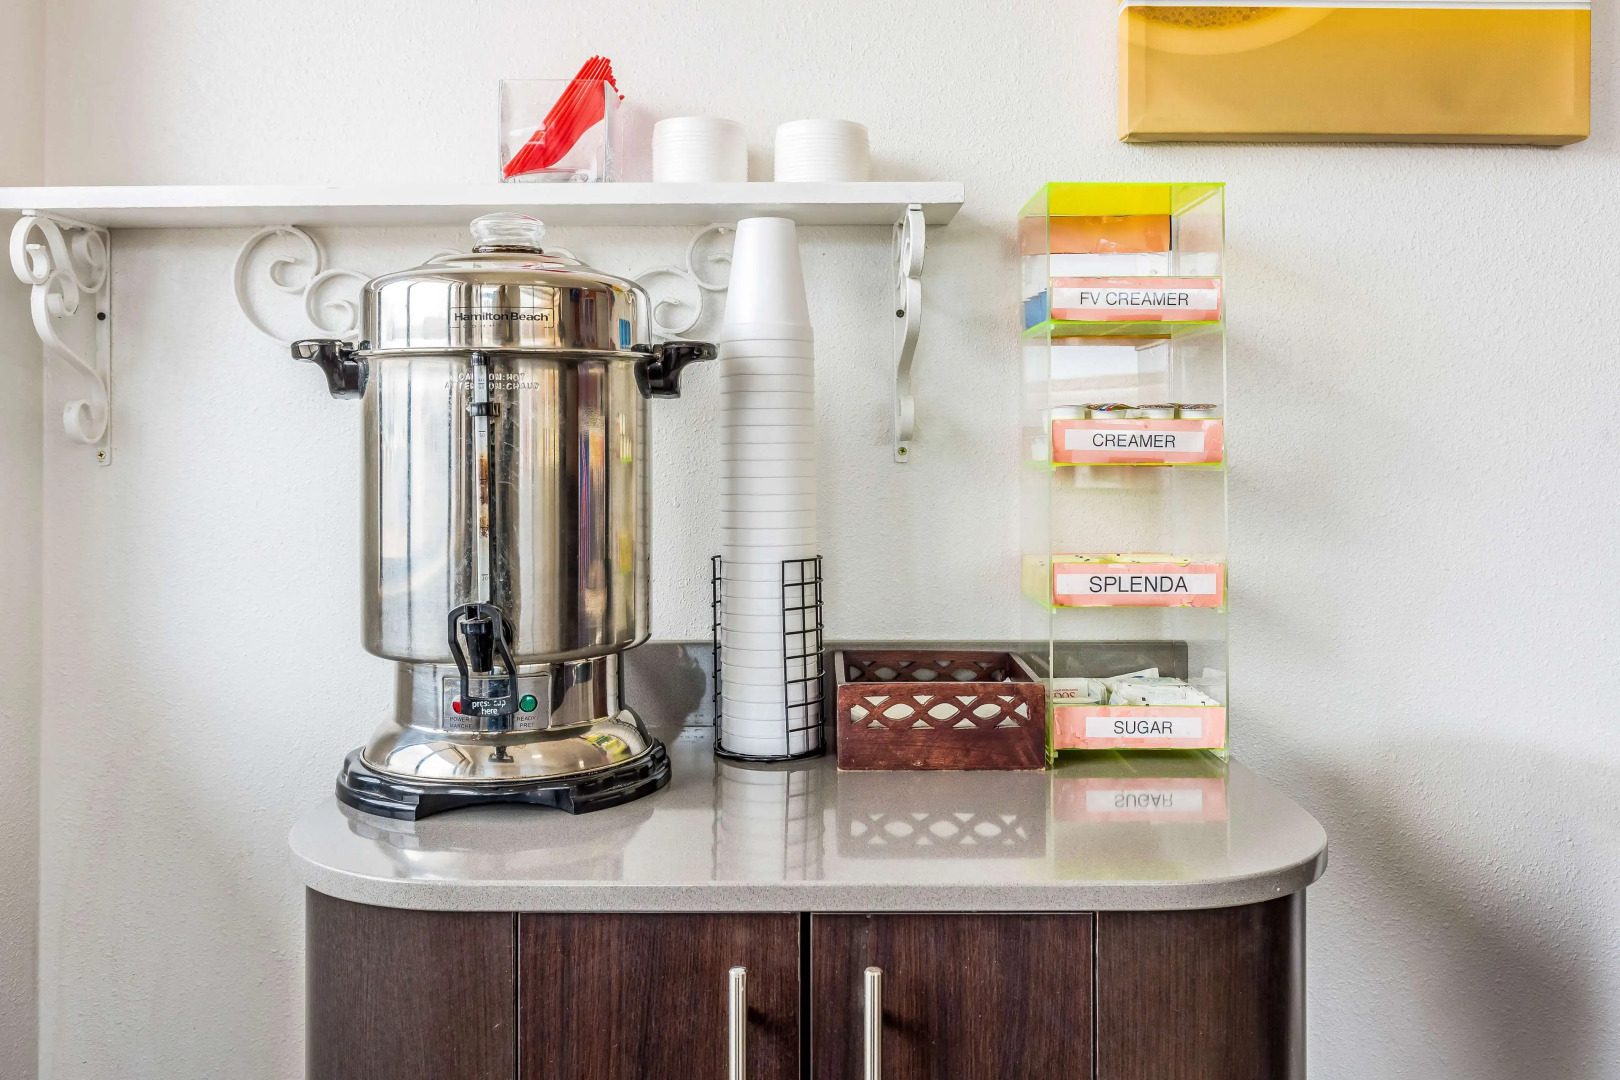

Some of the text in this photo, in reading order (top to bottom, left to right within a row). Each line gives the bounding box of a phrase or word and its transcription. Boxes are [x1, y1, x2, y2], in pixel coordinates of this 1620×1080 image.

[1079, 291, 1189, 306] FV CREAMER
[454, 312, 549, 321] Hamilton Beach
[1092, 433, 1176, 448] CREAMER
[1089, 576, 1188, 593] SPLENDA
[481, 707, 498, 716] here
[1113, 720, 1173, 735] SUGAR
